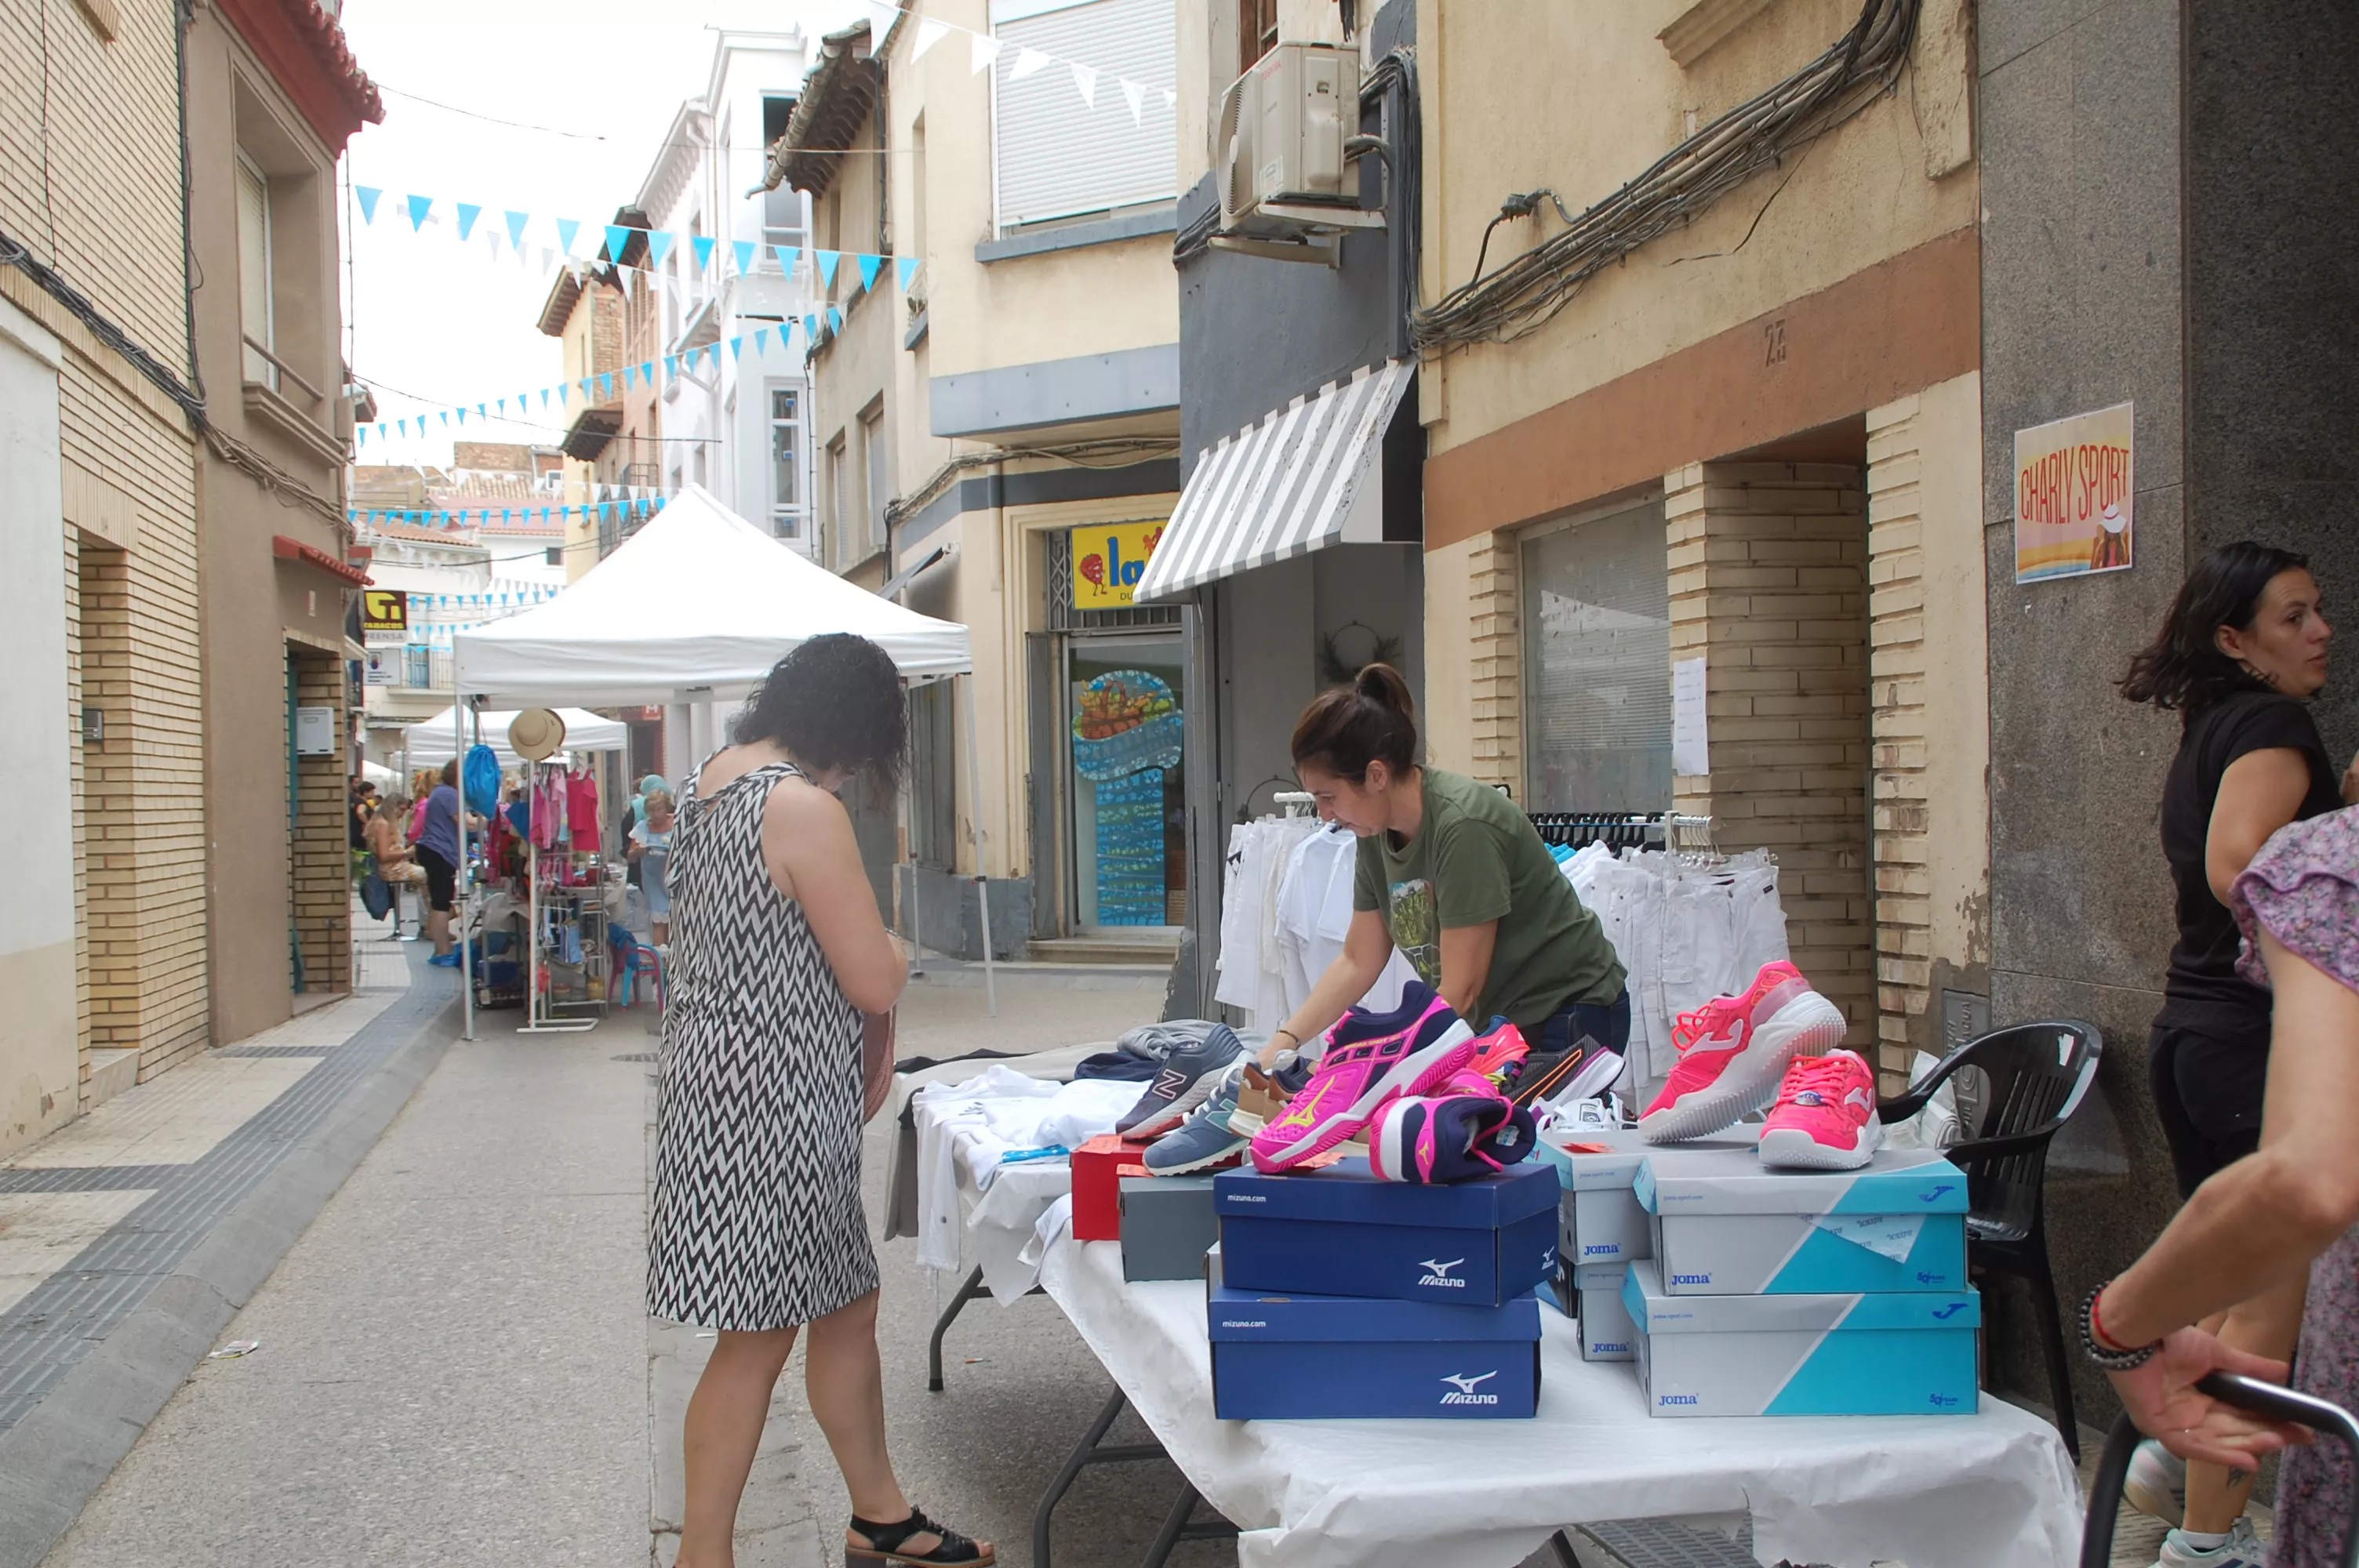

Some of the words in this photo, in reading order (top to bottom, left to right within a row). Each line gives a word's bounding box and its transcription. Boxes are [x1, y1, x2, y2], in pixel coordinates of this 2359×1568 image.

[2021, 445, 2075, 524] CHARLY
[2078, 444, 2129, 521] SPORT
[1227, 1193, 1267, 1203] mizuno.com
[1418, 1275, 1465, 1287] MIZUNO
[1222, 1319, 1267, 1328] mizuno.com
[1439, 1392, 1498, 1405] MIZUNO
